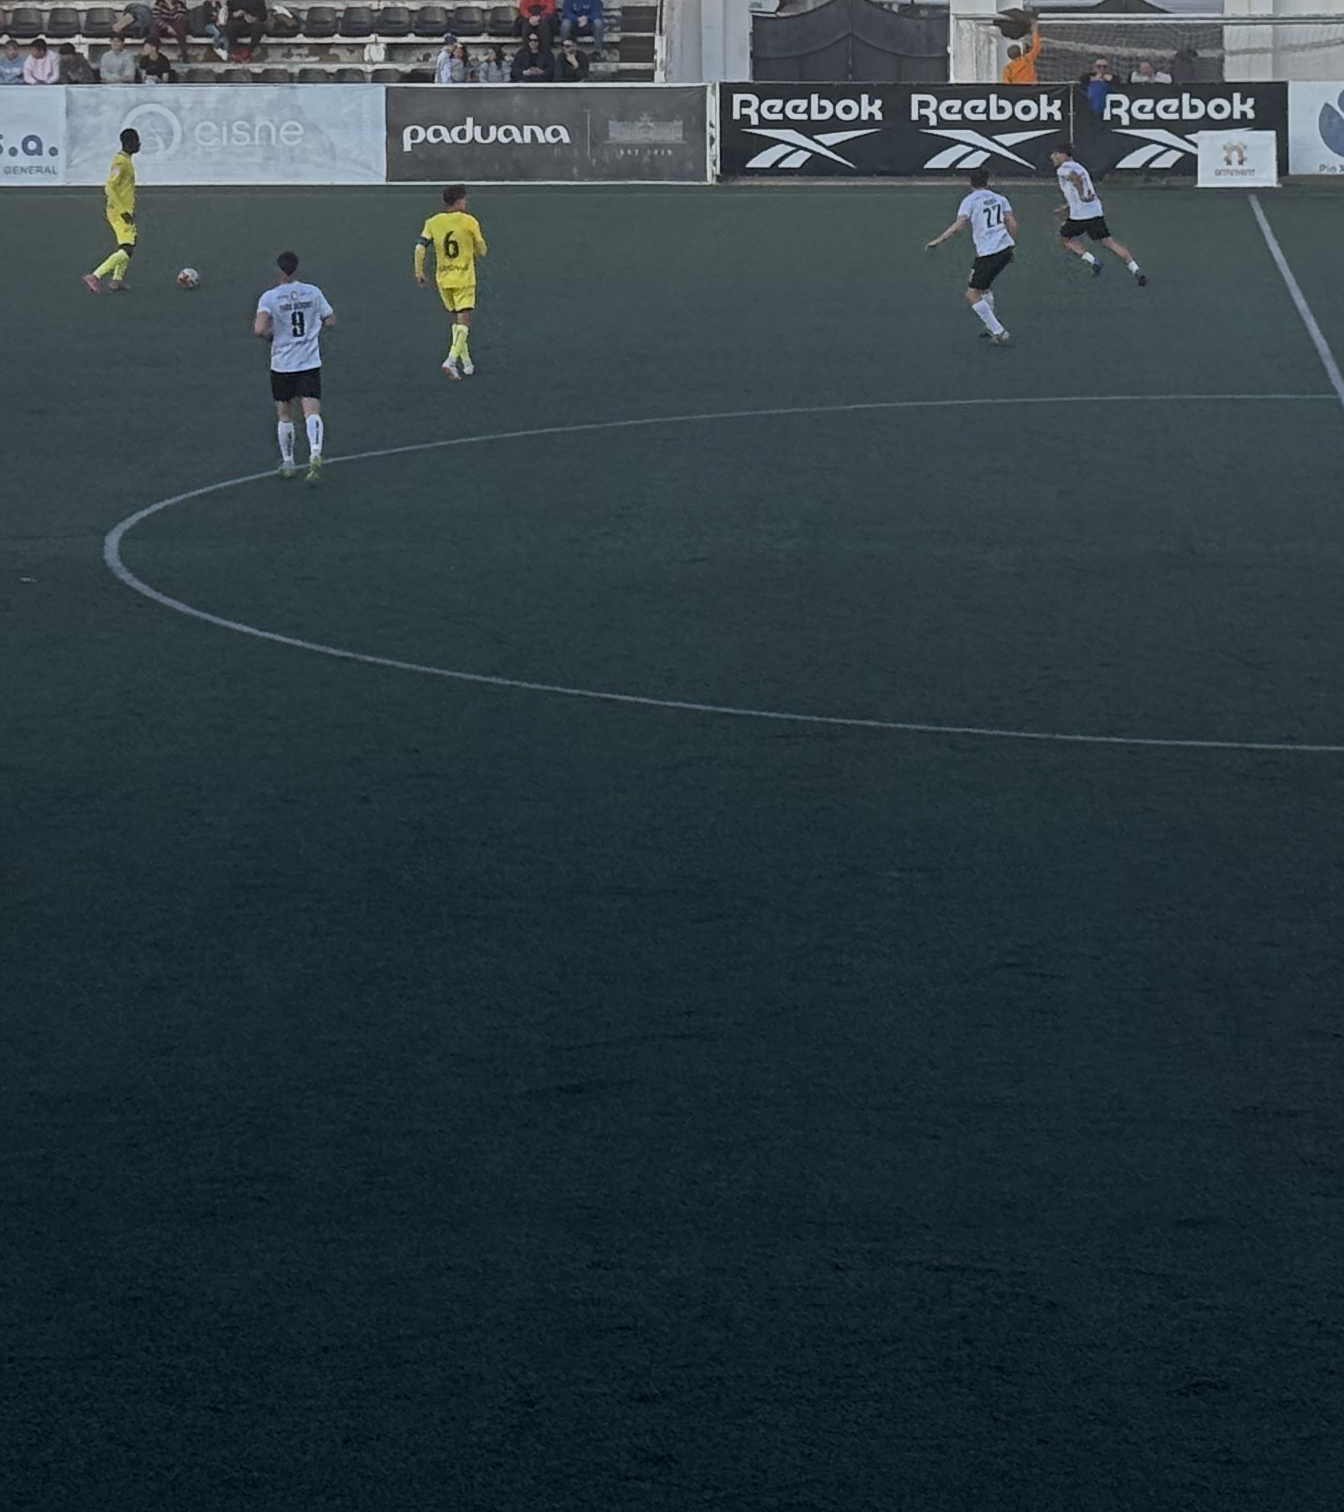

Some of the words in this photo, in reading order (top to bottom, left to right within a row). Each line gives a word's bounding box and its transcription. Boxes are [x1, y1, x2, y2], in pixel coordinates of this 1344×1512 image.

[732, 93, 883, 126] Reebok
[911, 93, 1063, 126] Reebok
[1103, 92, 1255, 125] Reebok
[403, 117, 571, 152] paduana
[4, 164, 58, 176] GENERAL
[443, 230, 460, 259] 6
[291, 311, 305, 337] 9
